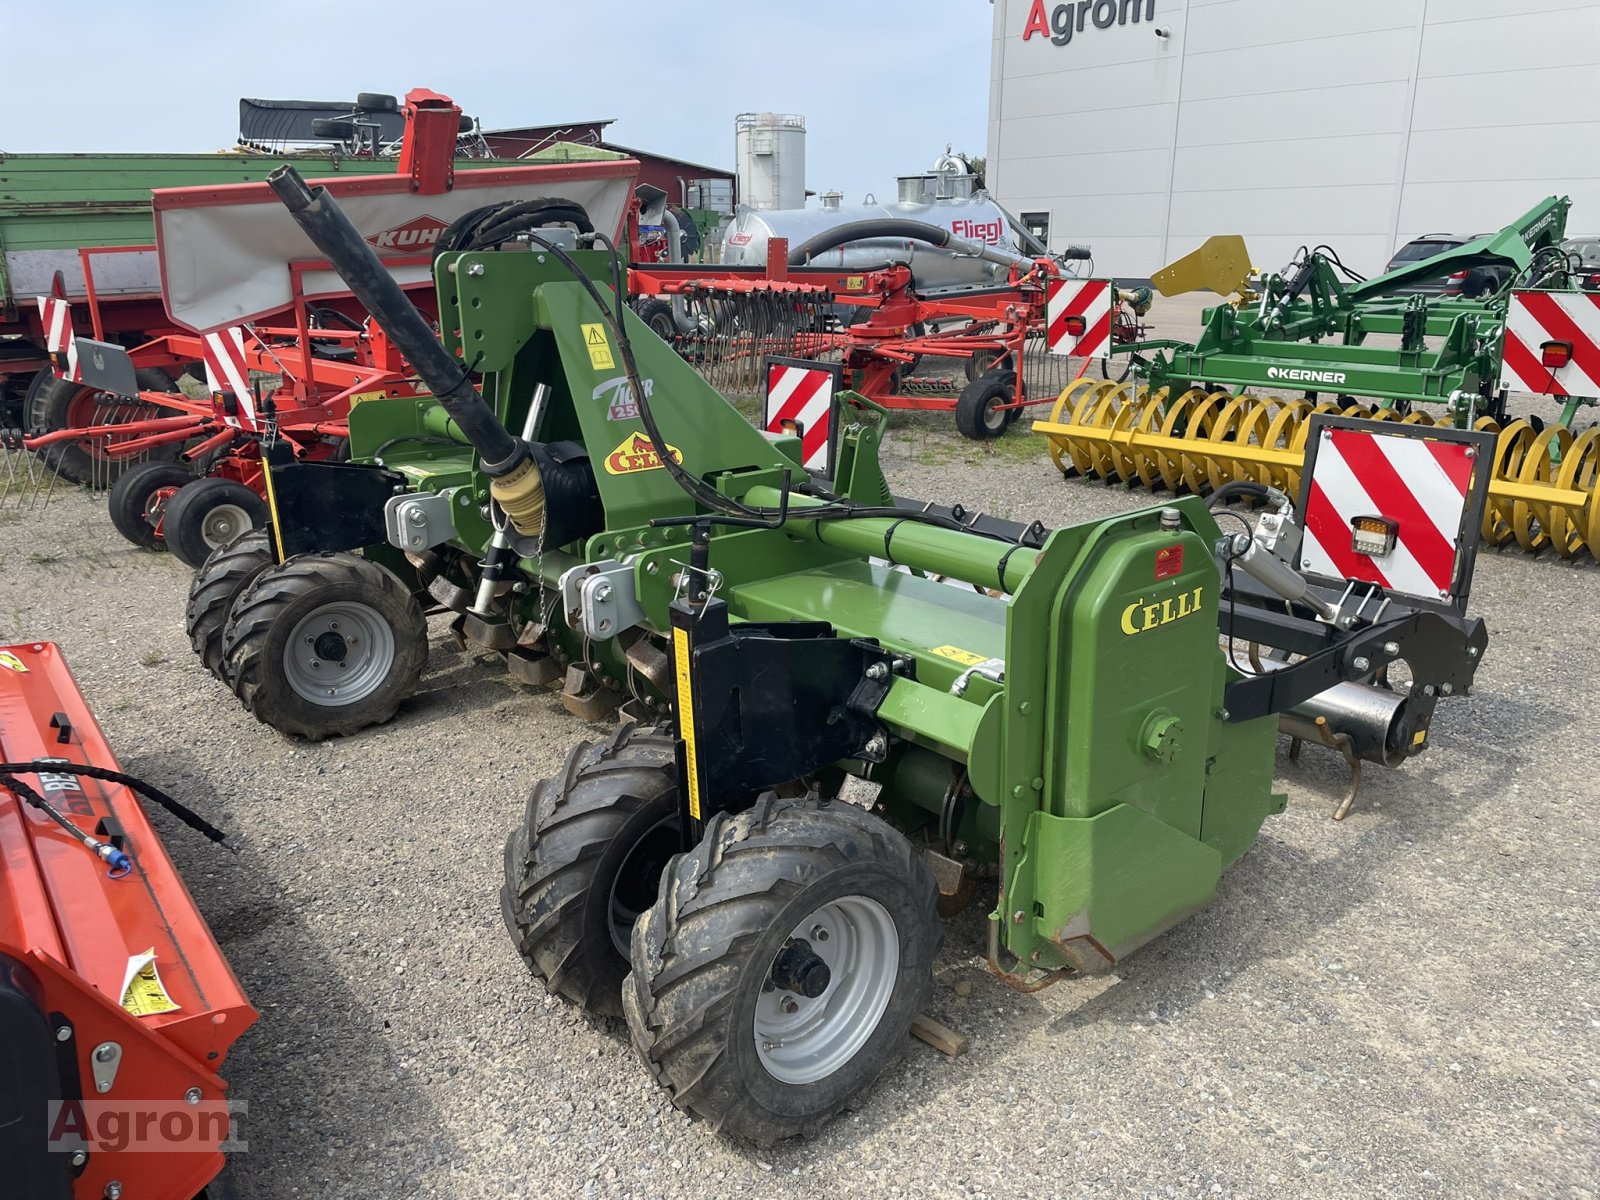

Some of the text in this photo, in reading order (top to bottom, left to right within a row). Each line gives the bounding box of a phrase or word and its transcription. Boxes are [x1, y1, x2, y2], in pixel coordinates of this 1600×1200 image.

[1022, 0, 1156, 46] Agrom
[375, 227, 449, 247] KUH
[951, 217, 1003, 246] Fliegl
[1523, 211, 1552, 242] KERNER
[1278, 367, 1346, 384] KERNER
[592, 375, 654, 421] TIGR
[1120, 586, 1203, 636] CELLI
